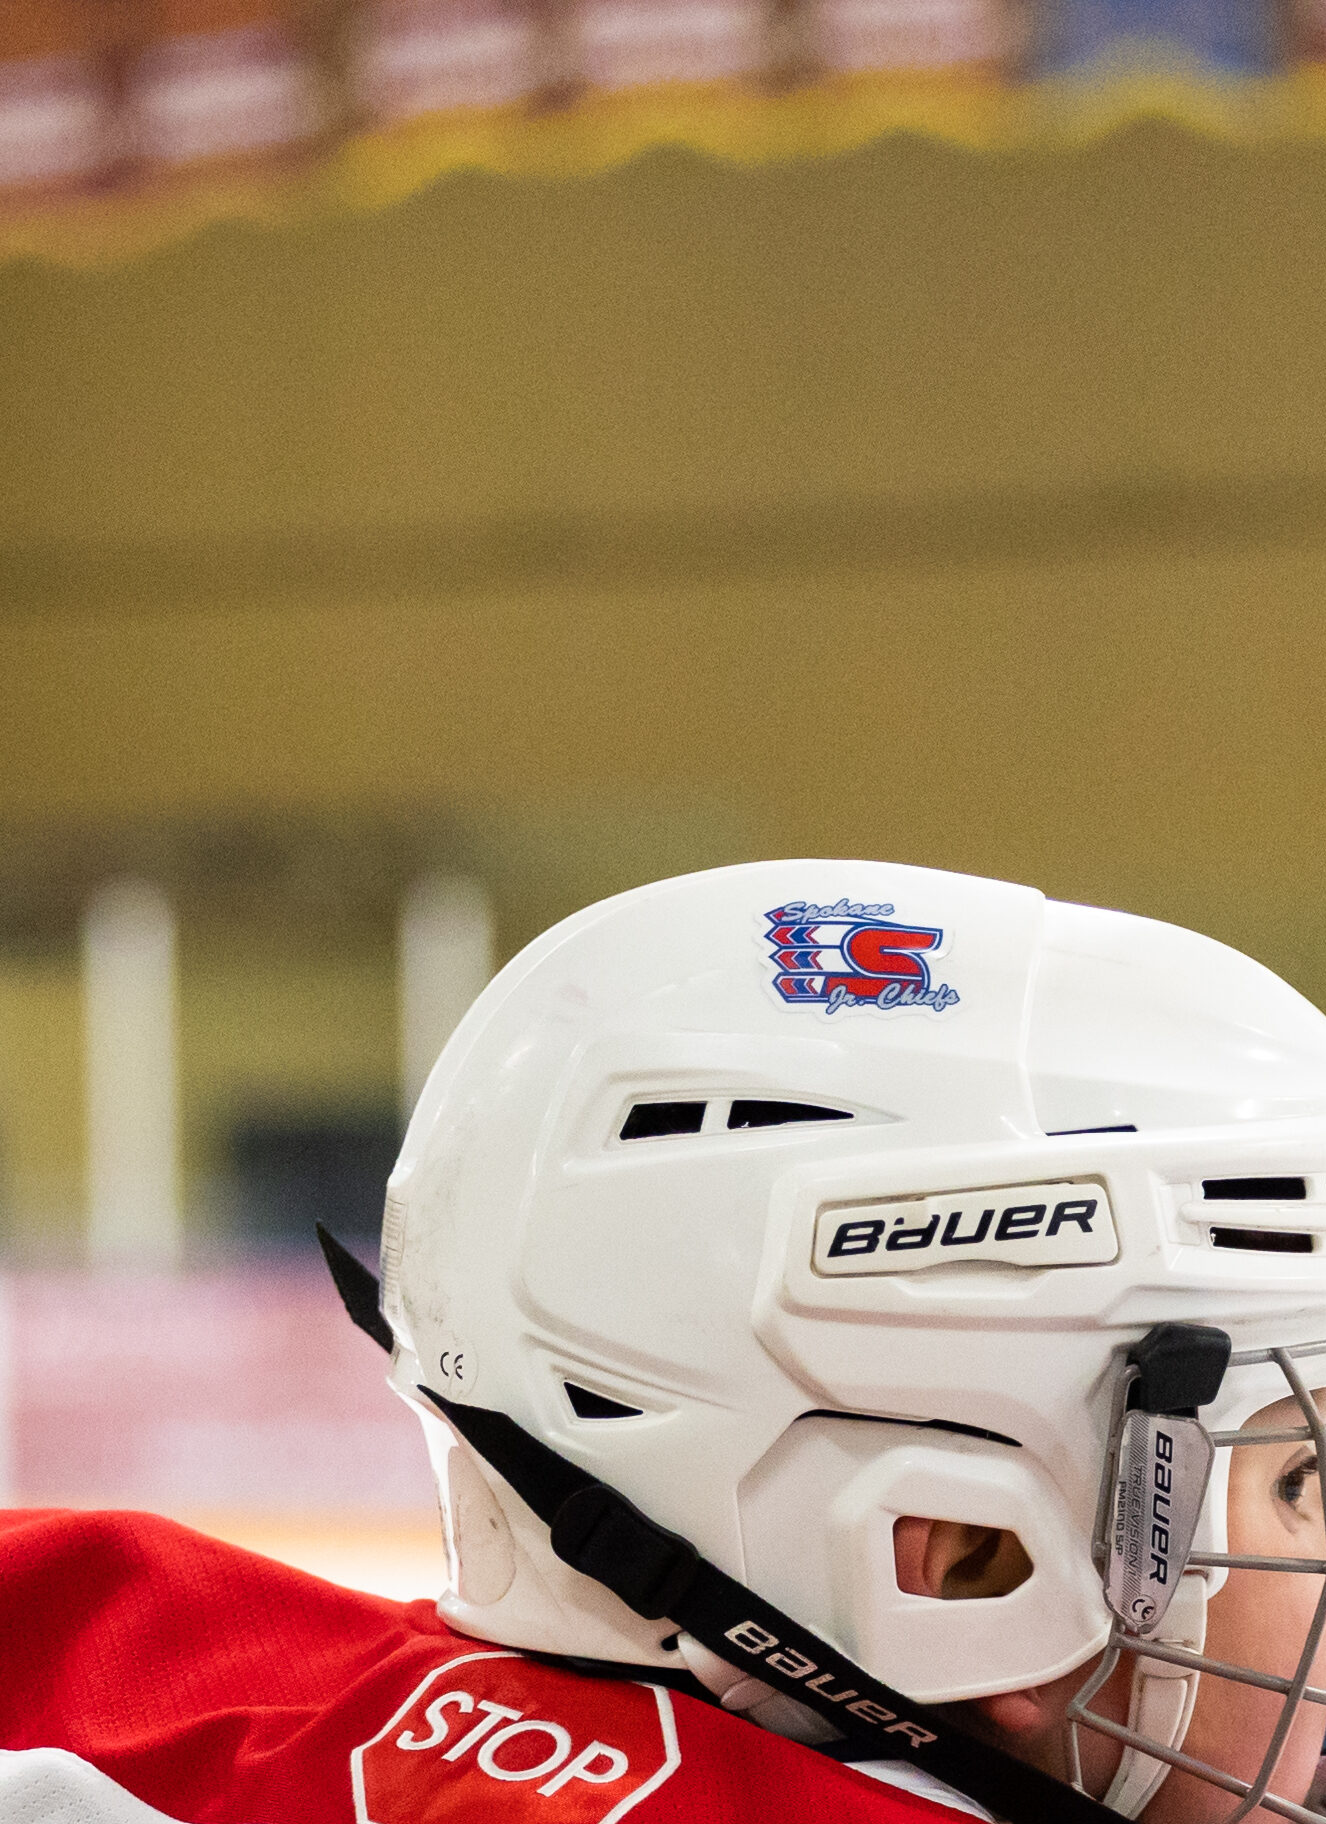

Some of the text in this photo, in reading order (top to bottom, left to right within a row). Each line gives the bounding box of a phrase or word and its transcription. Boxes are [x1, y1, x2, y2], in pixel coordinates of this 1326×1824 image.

[781, 898, 895, 923] Spokane
[825, 982, 961, 1015] Jr. Chiefs
[826, 1198, 1098, 1258] BAUER
[1149, 1430, 1174, 1586] BAUER
[723, 1620, 939, 1748] BAUER
[396, 1690, 629, 1797] STOP
